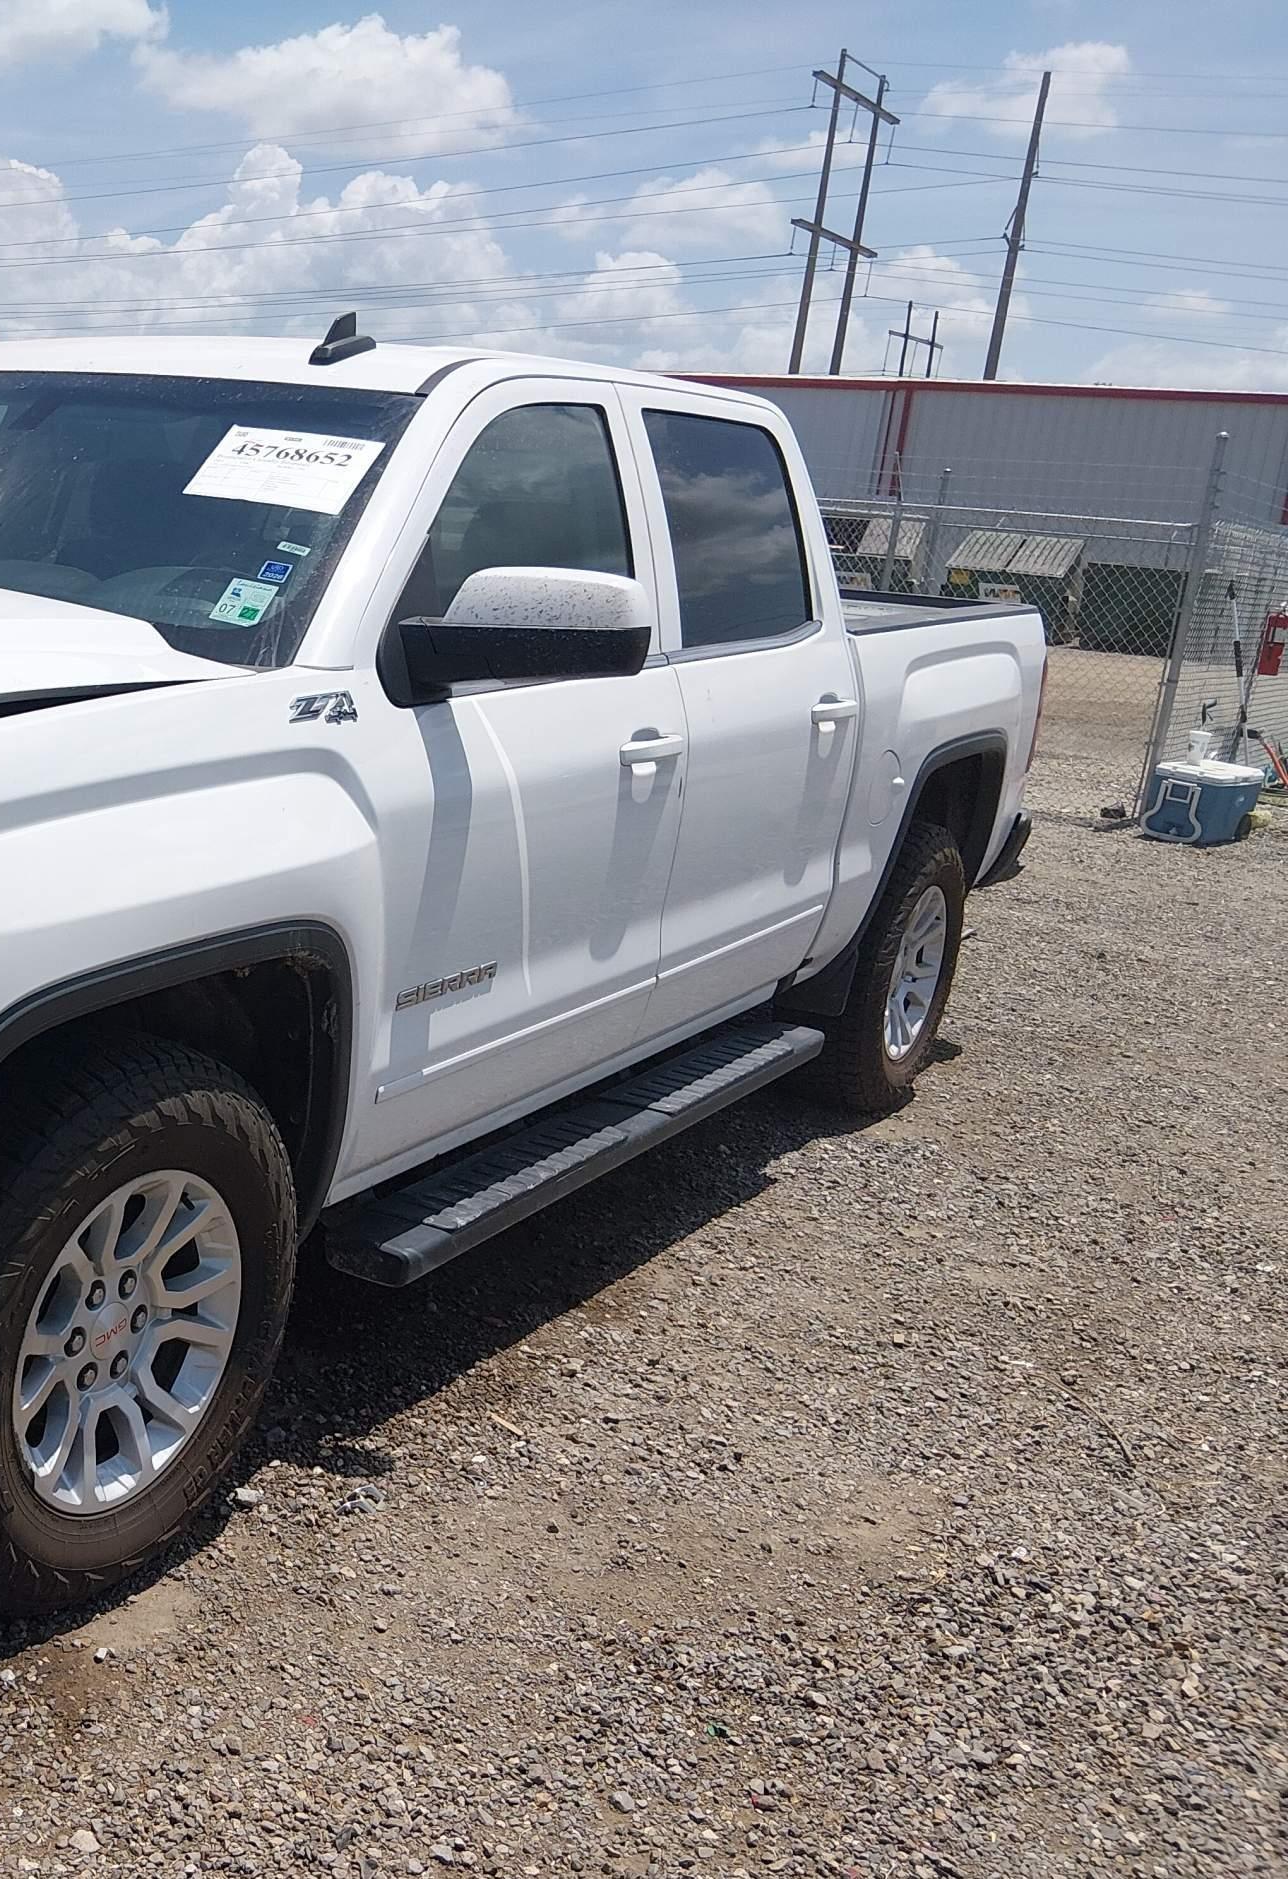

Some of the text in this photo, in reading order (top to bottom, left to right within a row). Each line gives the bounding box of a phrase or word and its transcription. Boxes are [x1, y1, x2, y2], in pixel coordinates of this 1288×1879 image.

[232, 442, 352, 467] 45768652
[218, 603, 236, 615] 07
[395, 960, 498, 1012] SIERRA
[94, 1317, 128, 1348] GMC
